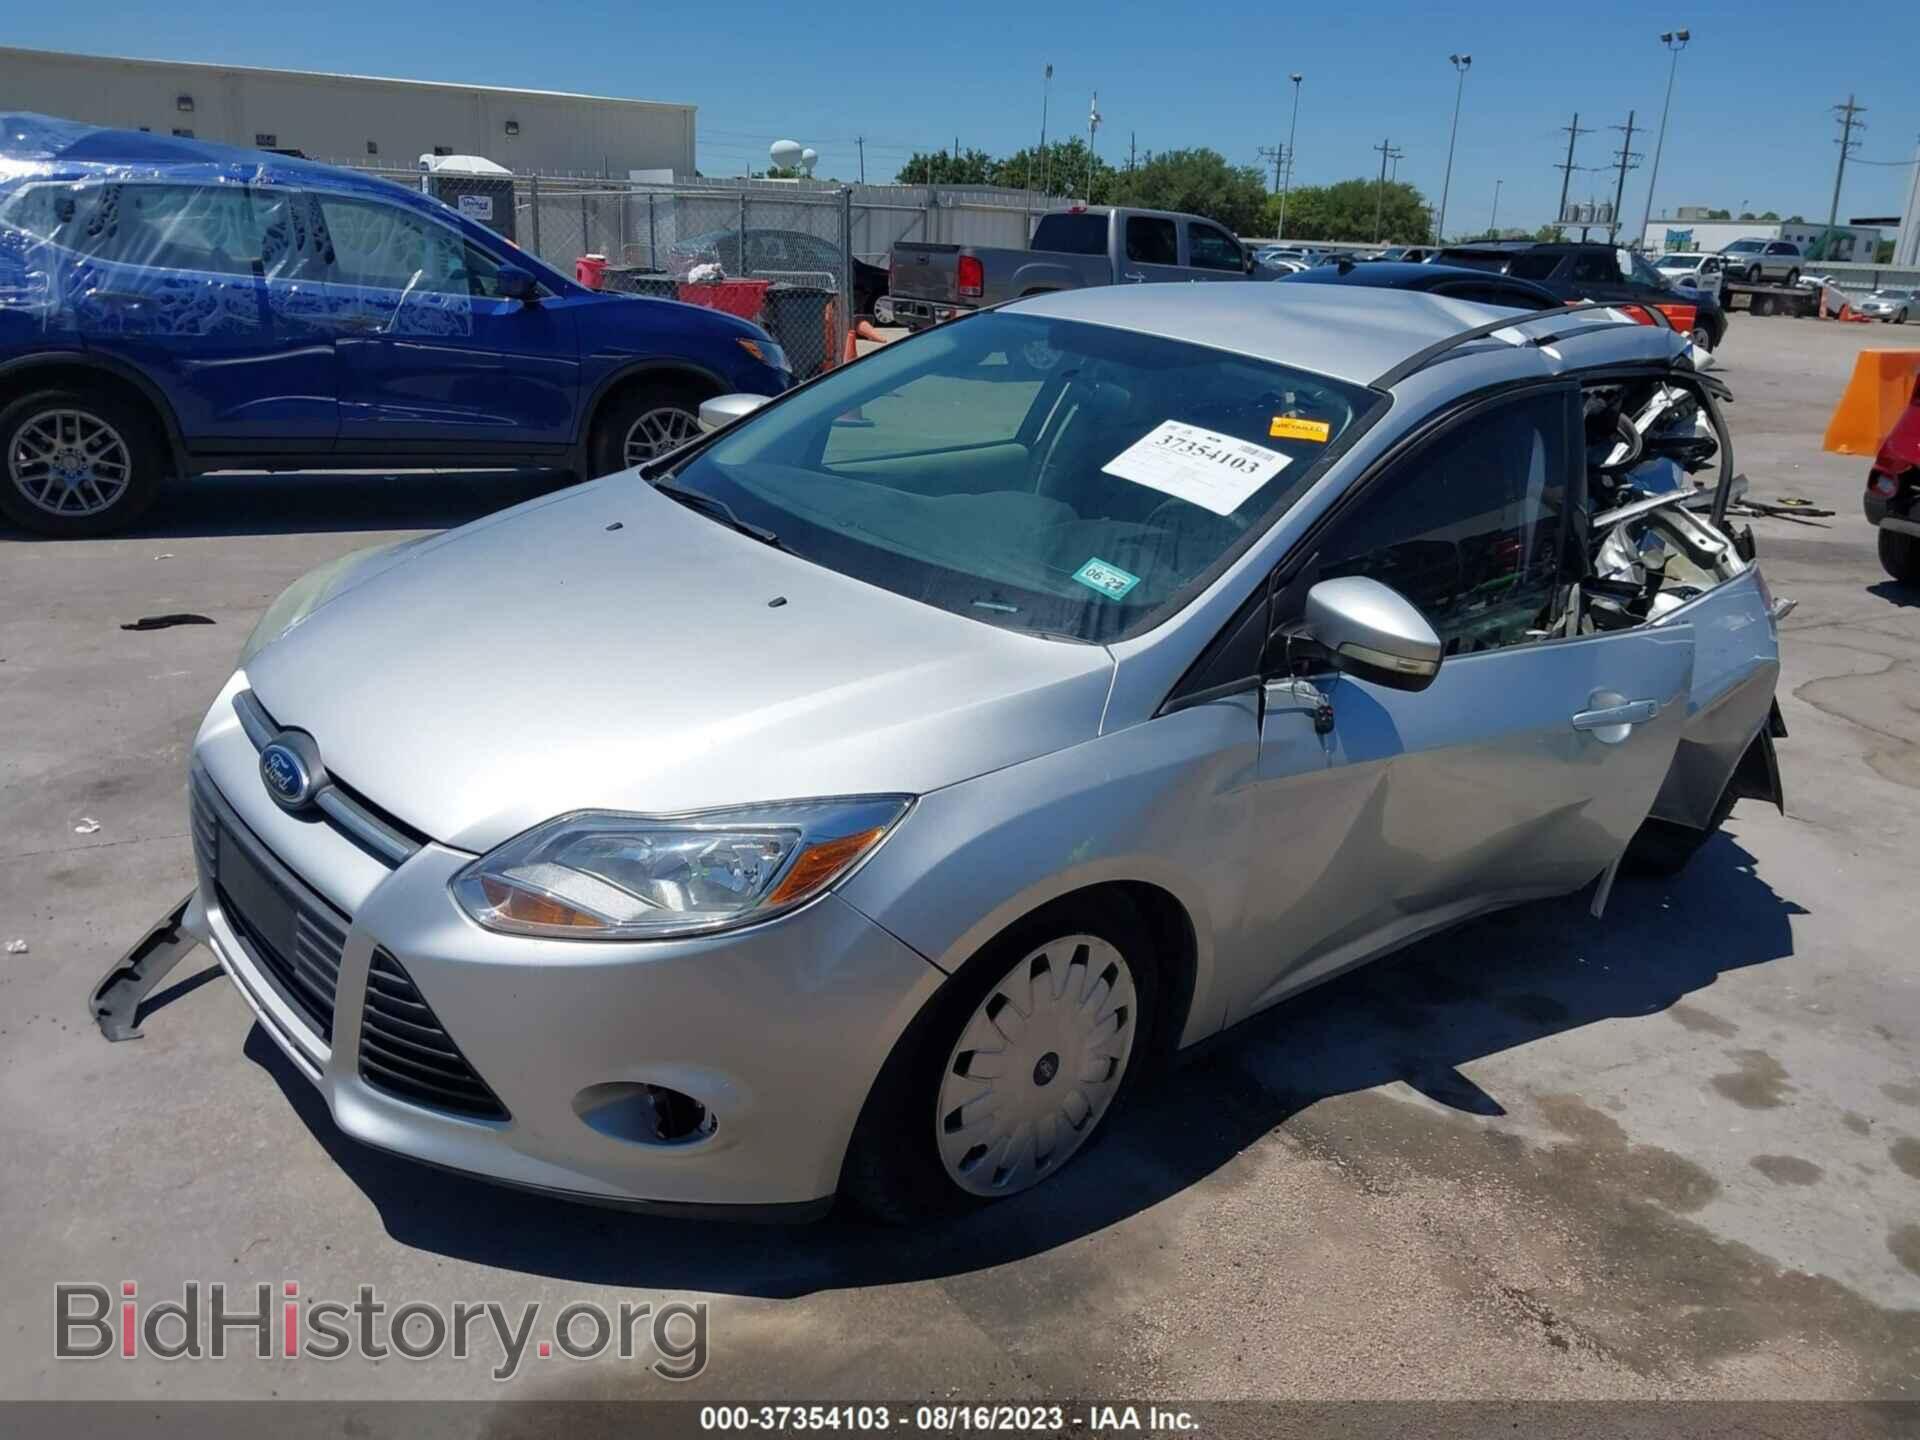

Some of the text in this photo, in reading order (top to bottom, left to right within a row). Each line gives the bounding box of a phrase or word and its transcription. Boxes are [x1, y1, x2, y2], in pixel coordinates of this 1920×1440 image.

[1154, 434, 1261, 474] 37354103
[1086, 568, 1104, 580] 06
[265, 753, 293, 790] Ford
